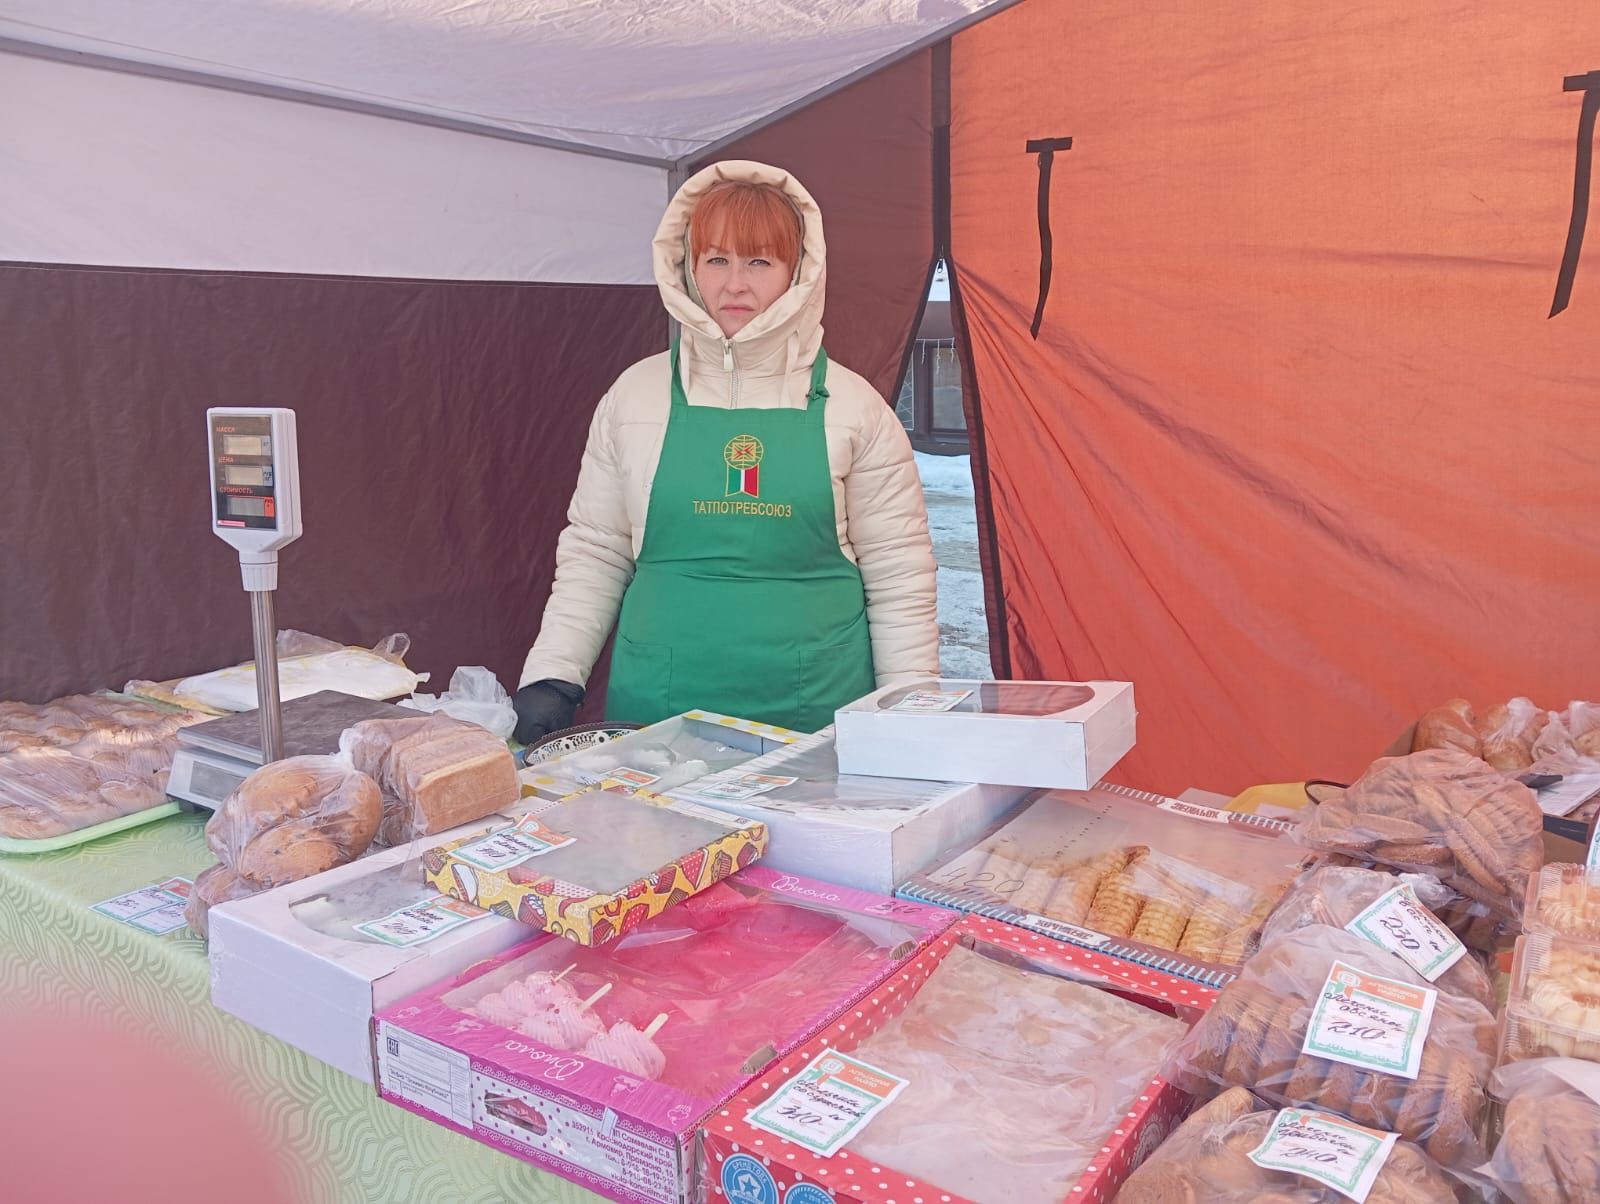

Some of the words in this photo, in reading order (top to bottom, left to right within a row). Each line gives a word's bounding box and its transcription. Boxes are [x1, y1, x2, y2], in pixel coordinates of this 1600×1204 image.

[692, 500, 792, 517] ТАТПОТРЕБСОЮЗ
[771, 875, 841, 902] Виола
[941, 866, 1025, 893] 420
[505, 1039, 585, 1081] Виола
